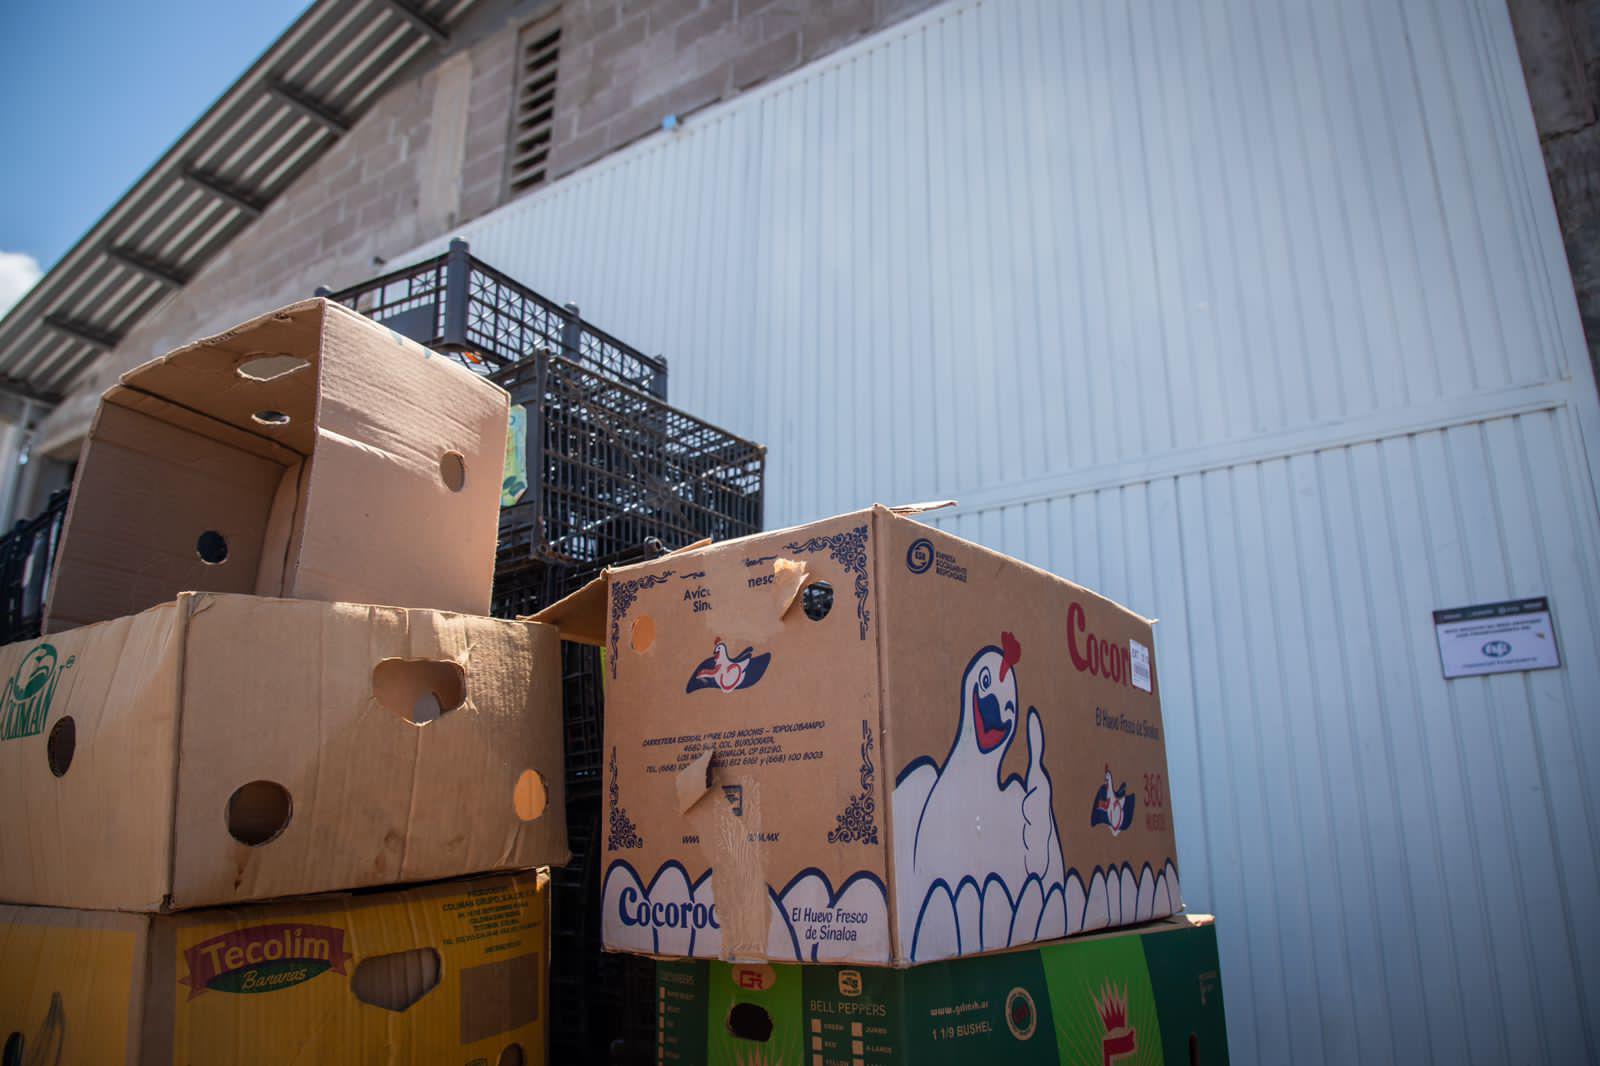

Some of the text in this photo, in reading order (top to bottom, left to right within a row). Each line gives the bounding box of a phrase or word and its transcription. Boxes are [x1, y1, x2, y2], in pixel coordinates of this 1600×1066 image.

[1066, 601, 1131, 687] Cocor
[618, 885, 721, 930] Cocoroc
[791, 906, 869, 925] El Huevo Fresco
[804, 924, 858, 942] de Sinaloa
[201, 928, 330, 977] Tecolim
[240, 966, 309, 991] Bananas
[810, 999, 888, 1017] BELL PEPPERS
[956, 1020, 993, 1038] BUSHEL
